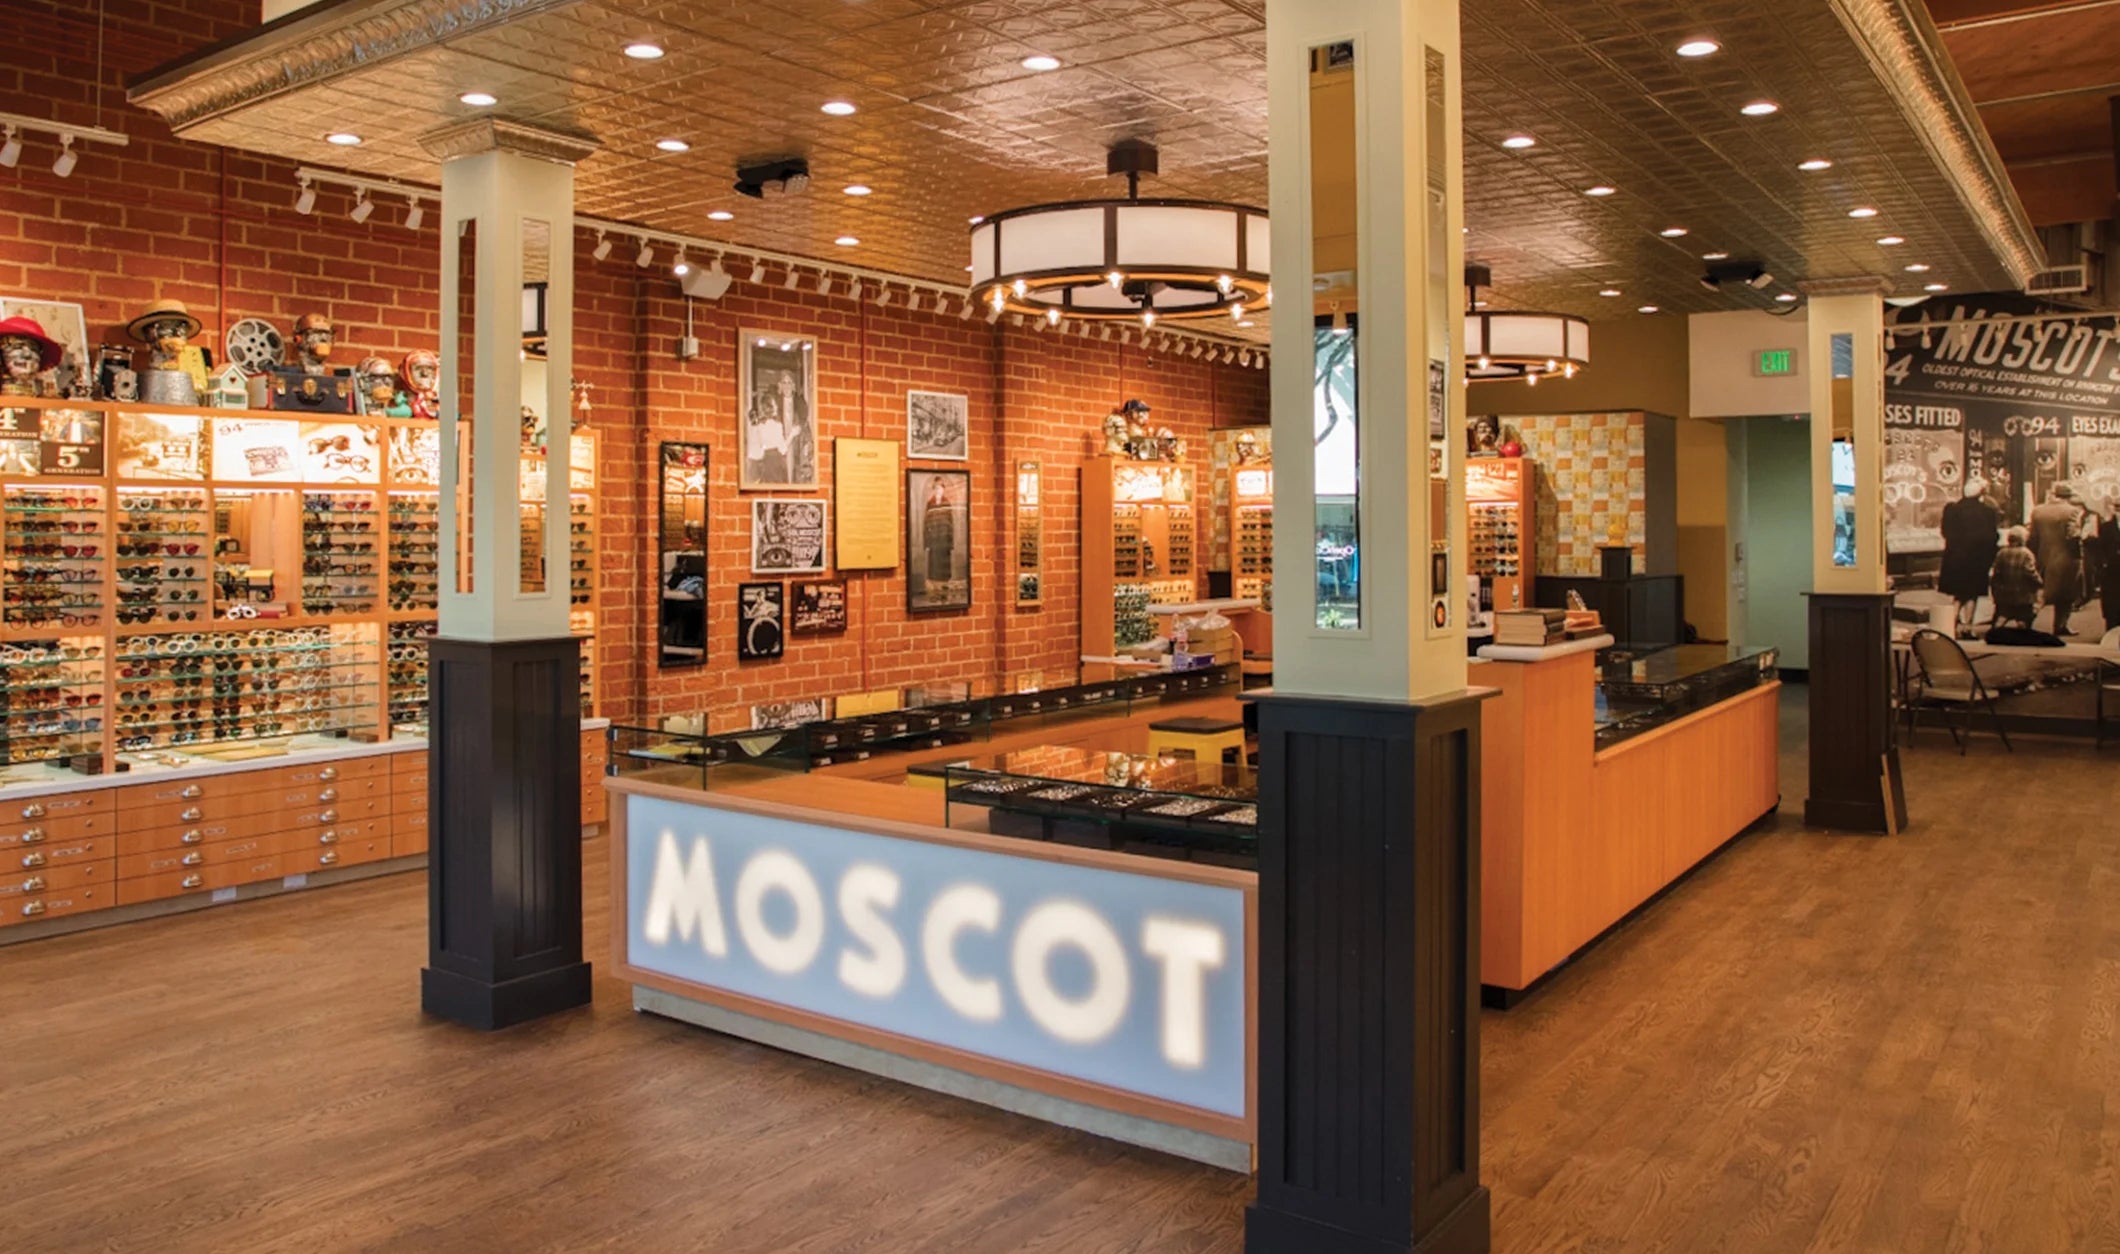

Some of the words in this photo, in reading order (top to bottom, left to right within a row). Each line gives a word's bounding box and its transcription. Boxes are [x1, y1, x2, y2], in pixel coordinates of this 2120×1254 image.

[1761, 350, 1790, 375] EXIT
[1884, 351, 1914, 386] 4
[1921, 363, 1960, 376] OLDEST
[1960, 365, 1997, 380] OPTICAL
[1997, 370, 2063, 387] ESTABLISHMENT
[1934, 380, 1966, 391] OVER
[1982, 385, 2016, 395] YEARS
[2017, 388, 2034, 396] AT
[2034, 389, 2057, 399] THIS
[2058, 392, 2109, 405] LOCATION
[1914, 405, 1962, 427] FITTED
[2031, 416, 2060, 435] 94
[2072, 415, 2098, 433] EYES
[644, 827, 1226, 1071] MOSCOT
